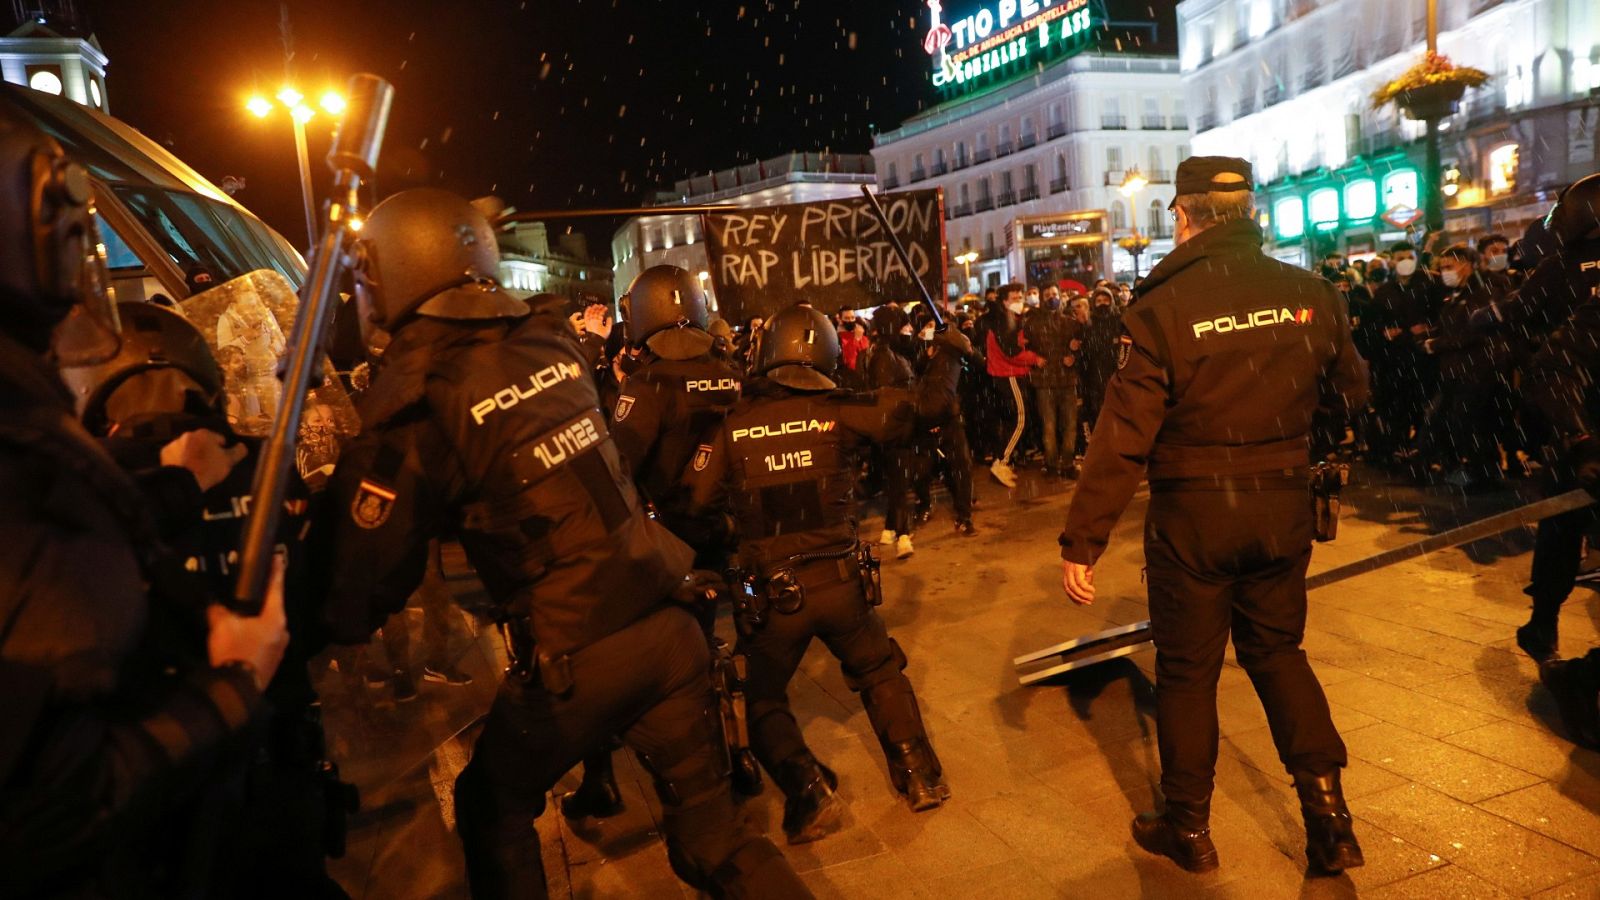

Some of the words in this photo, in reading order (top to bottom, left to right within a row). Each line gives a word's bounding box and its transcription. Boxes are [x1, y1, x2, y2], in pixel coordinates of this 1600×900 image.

[951, 8, 993, 49] TIO
[998, 0, 1051, 28] PE
[722, 213, 788, 247] REY
[722, 250, 779, 290] RAP
[792, 241, 930, 289] LIBERTAD
[1192, 308, 1295, 339] POLICIA
[470, 362, 573, 426] POLICIA
[686, 378, 735, 393] POLICIA
[533, 417, 599, 469] 1U1122
[732, 419, 822, 442] POLICIA
[764, 450, 814, 472] 1U112
